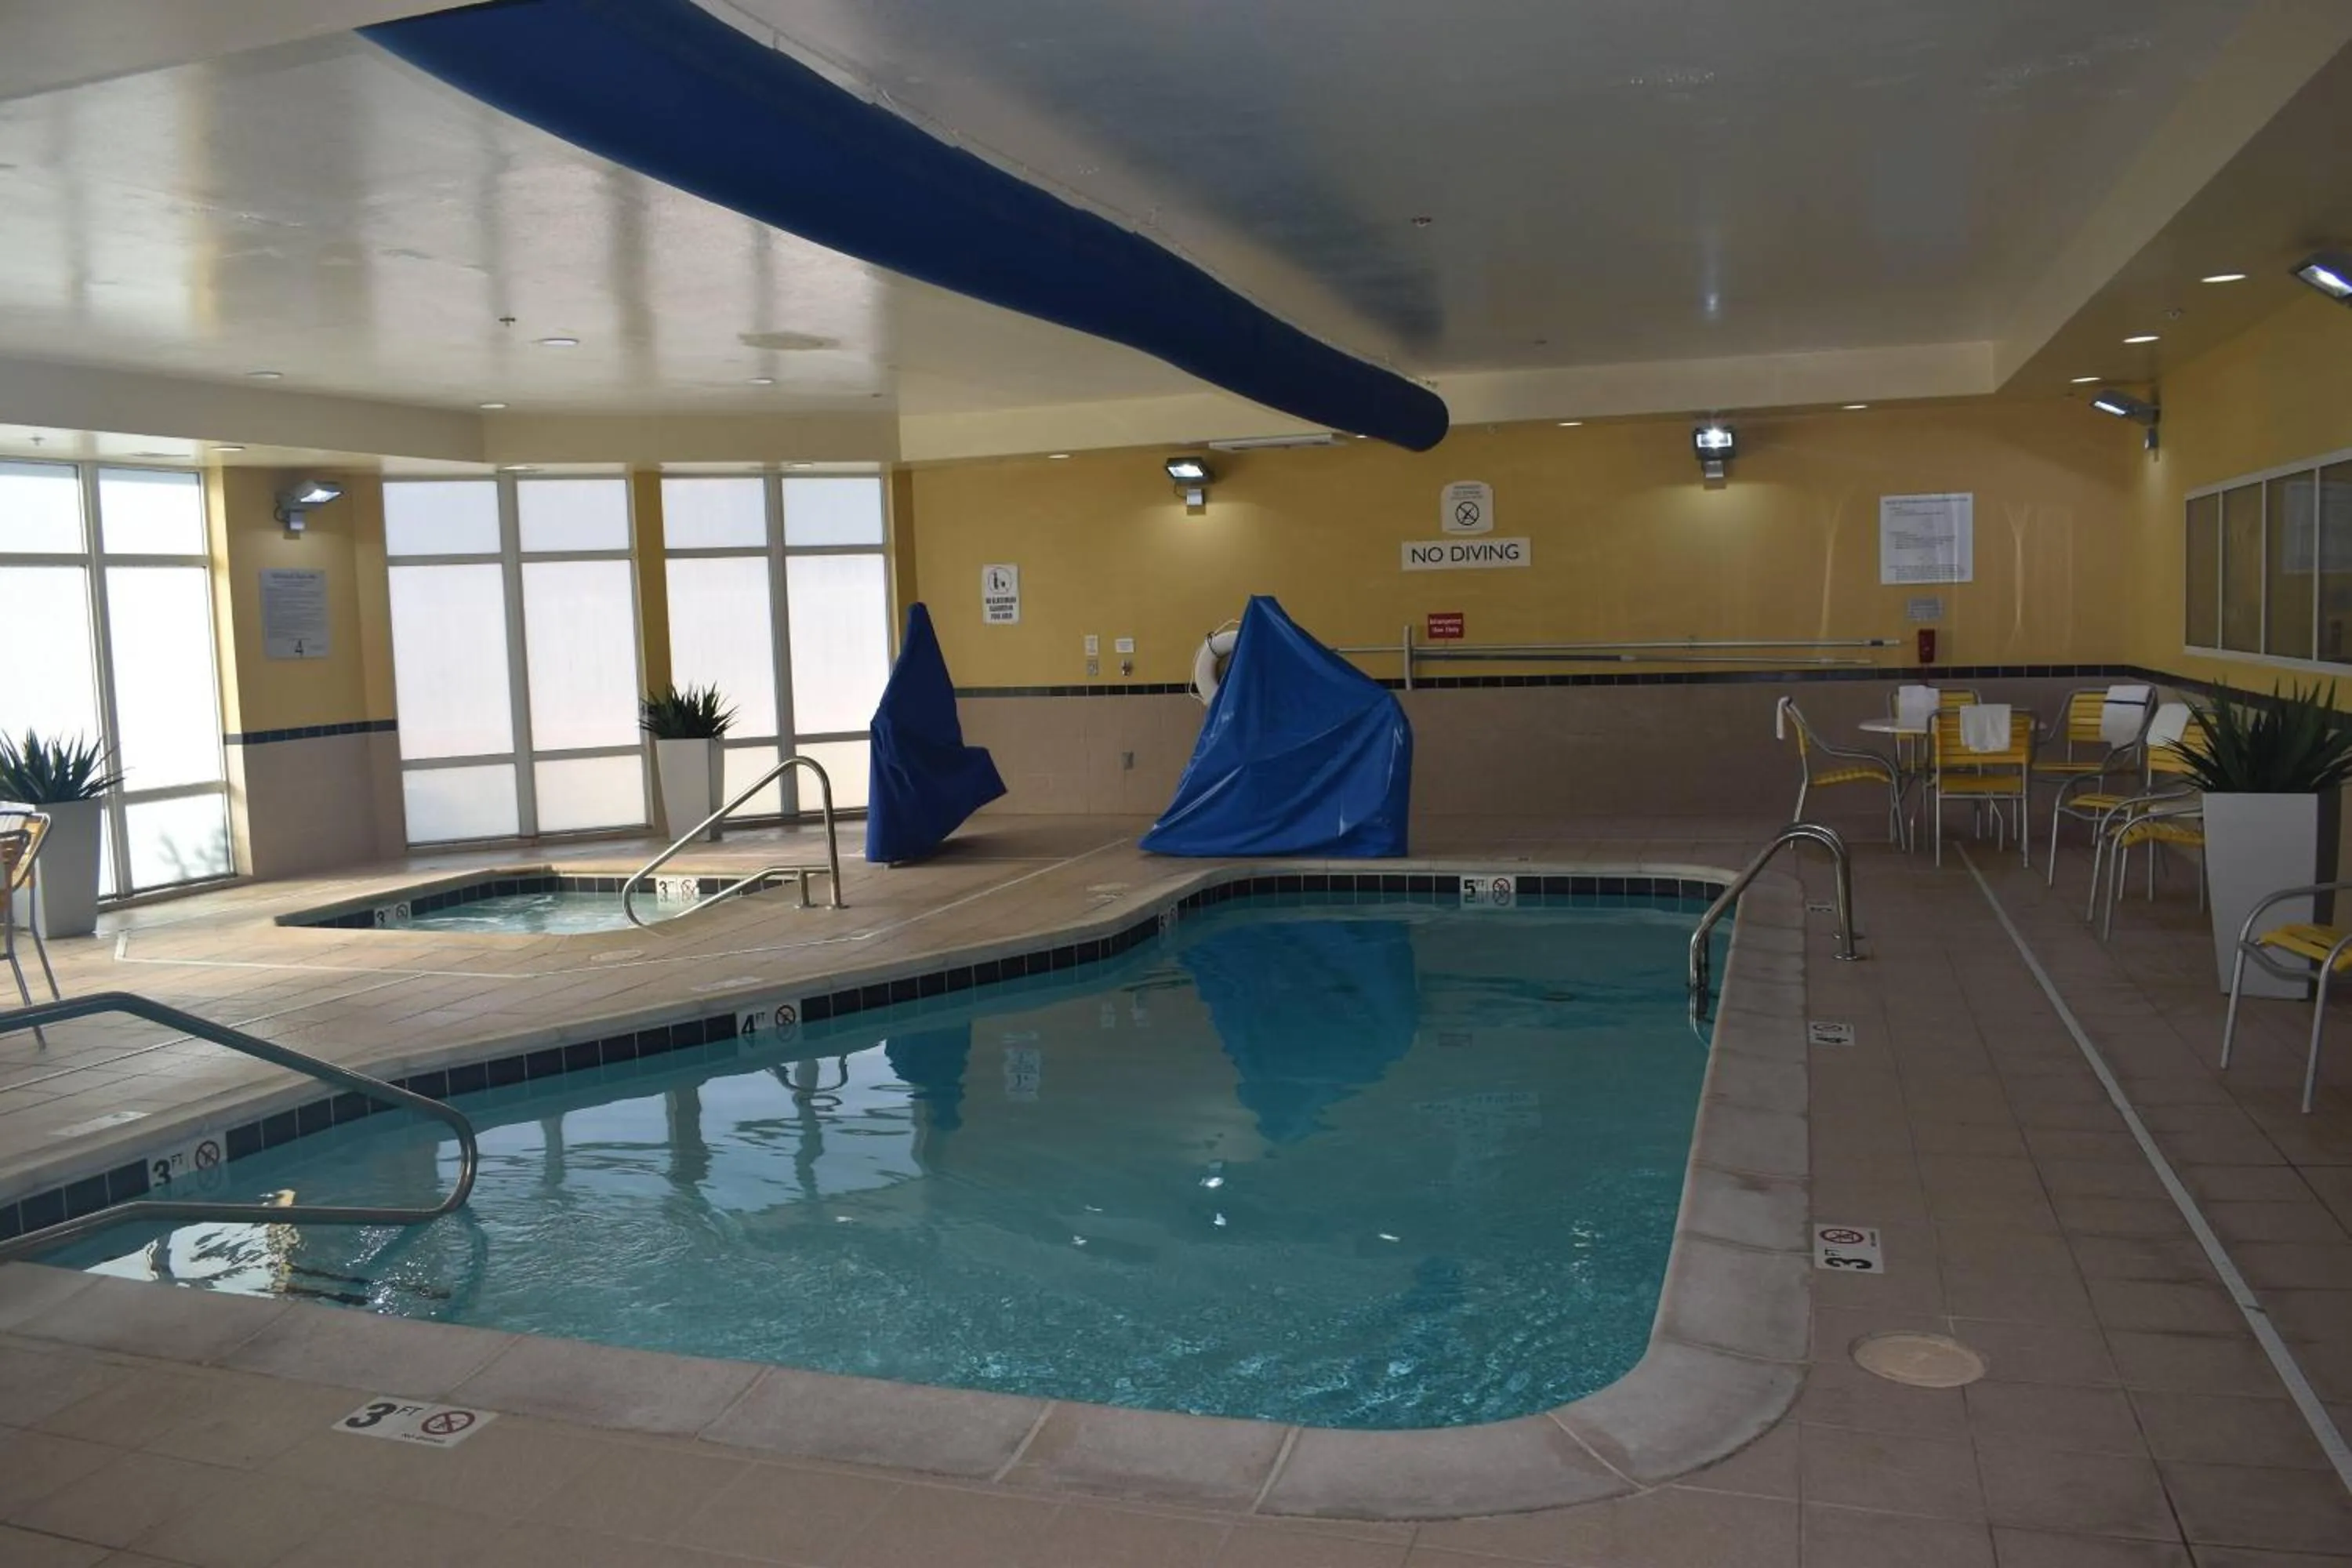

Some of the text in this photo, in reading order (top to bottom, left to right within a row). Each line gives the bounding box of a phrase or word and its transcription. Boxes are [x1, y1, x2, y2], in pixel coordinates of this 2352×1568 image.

[1411, 543, 1519, 563] NO DIVING
[1464, 879, 1475, 894] 5
[741, 1014, 755, 1034] 4
[152, 1152, 183, 1187] 3 FT
[1824, 1258, 1873, 1269] 3
[345, 1403, 423, 1428] 3 FT
